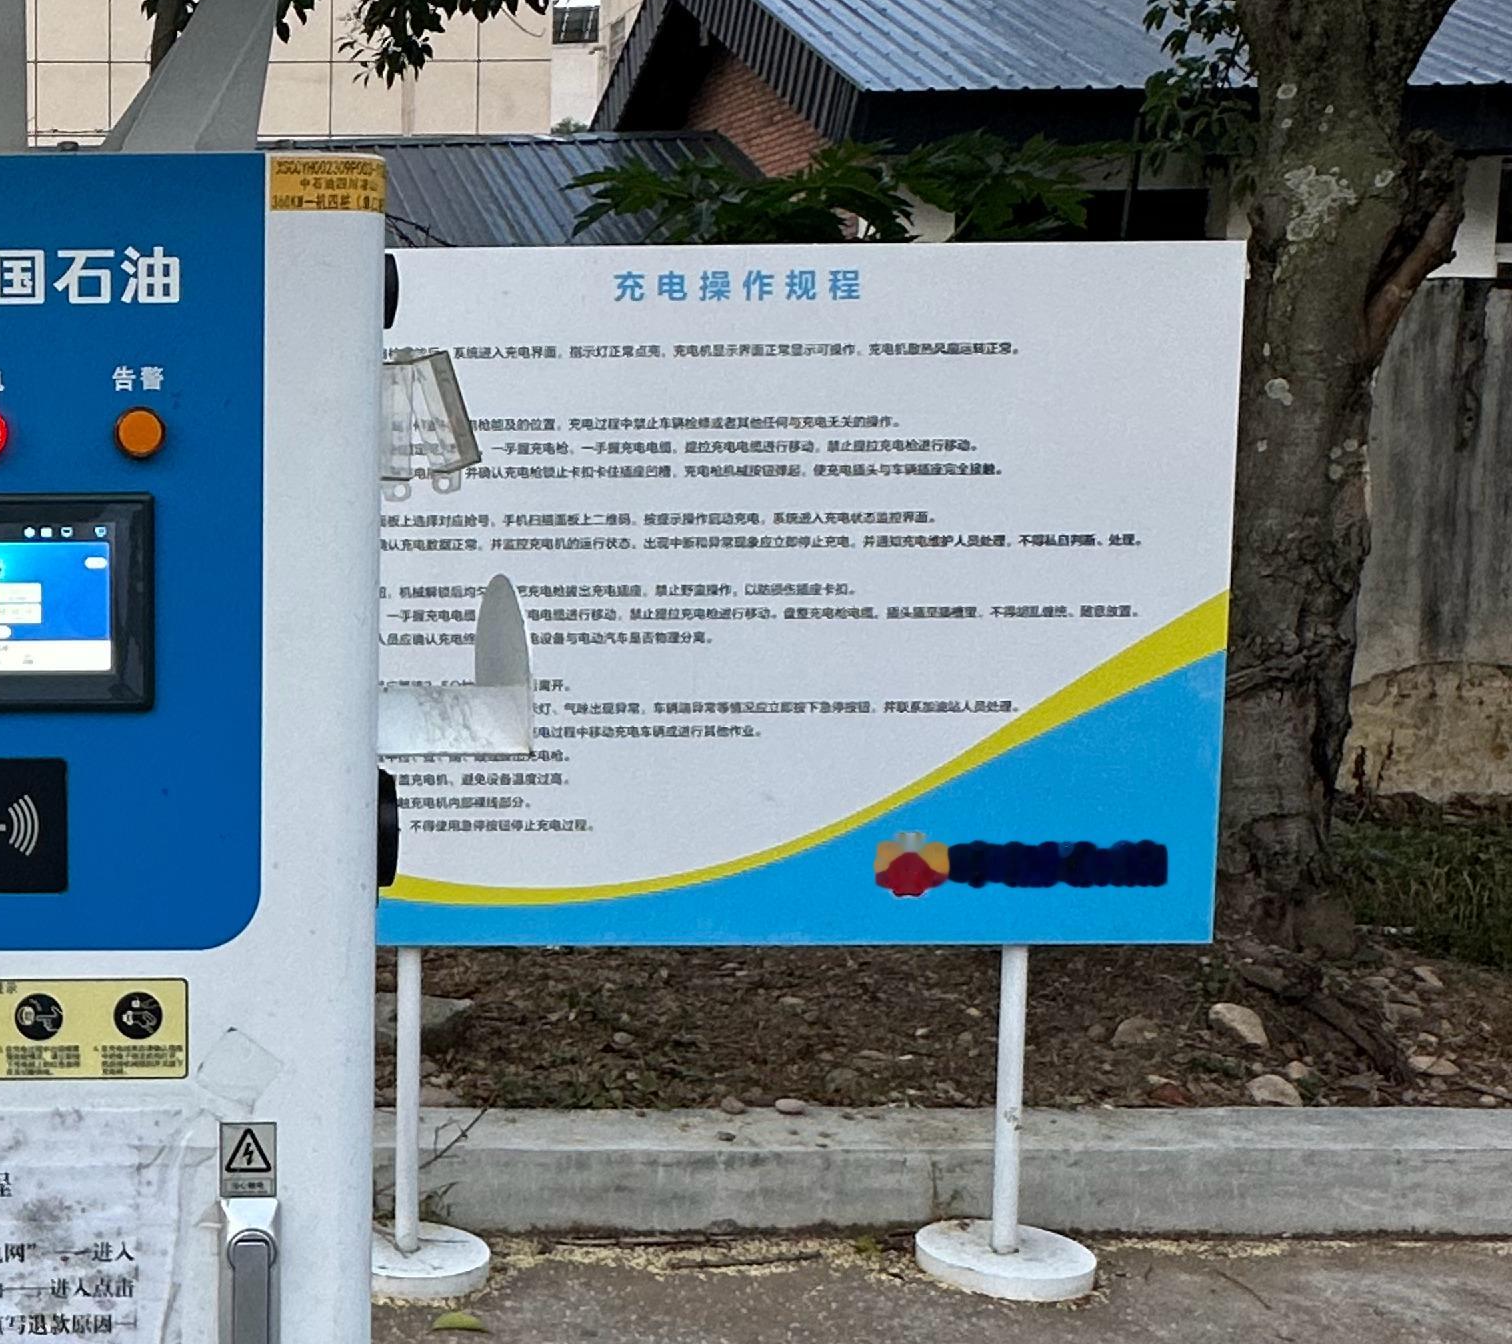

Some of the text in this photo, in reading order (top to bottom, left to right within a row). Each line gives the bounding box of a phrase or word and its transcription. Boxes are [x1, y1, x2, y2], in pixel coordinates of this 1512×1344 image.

[614, 270, 860, 301] 充电操作规程
[112, 366, 163, 391] 告警
